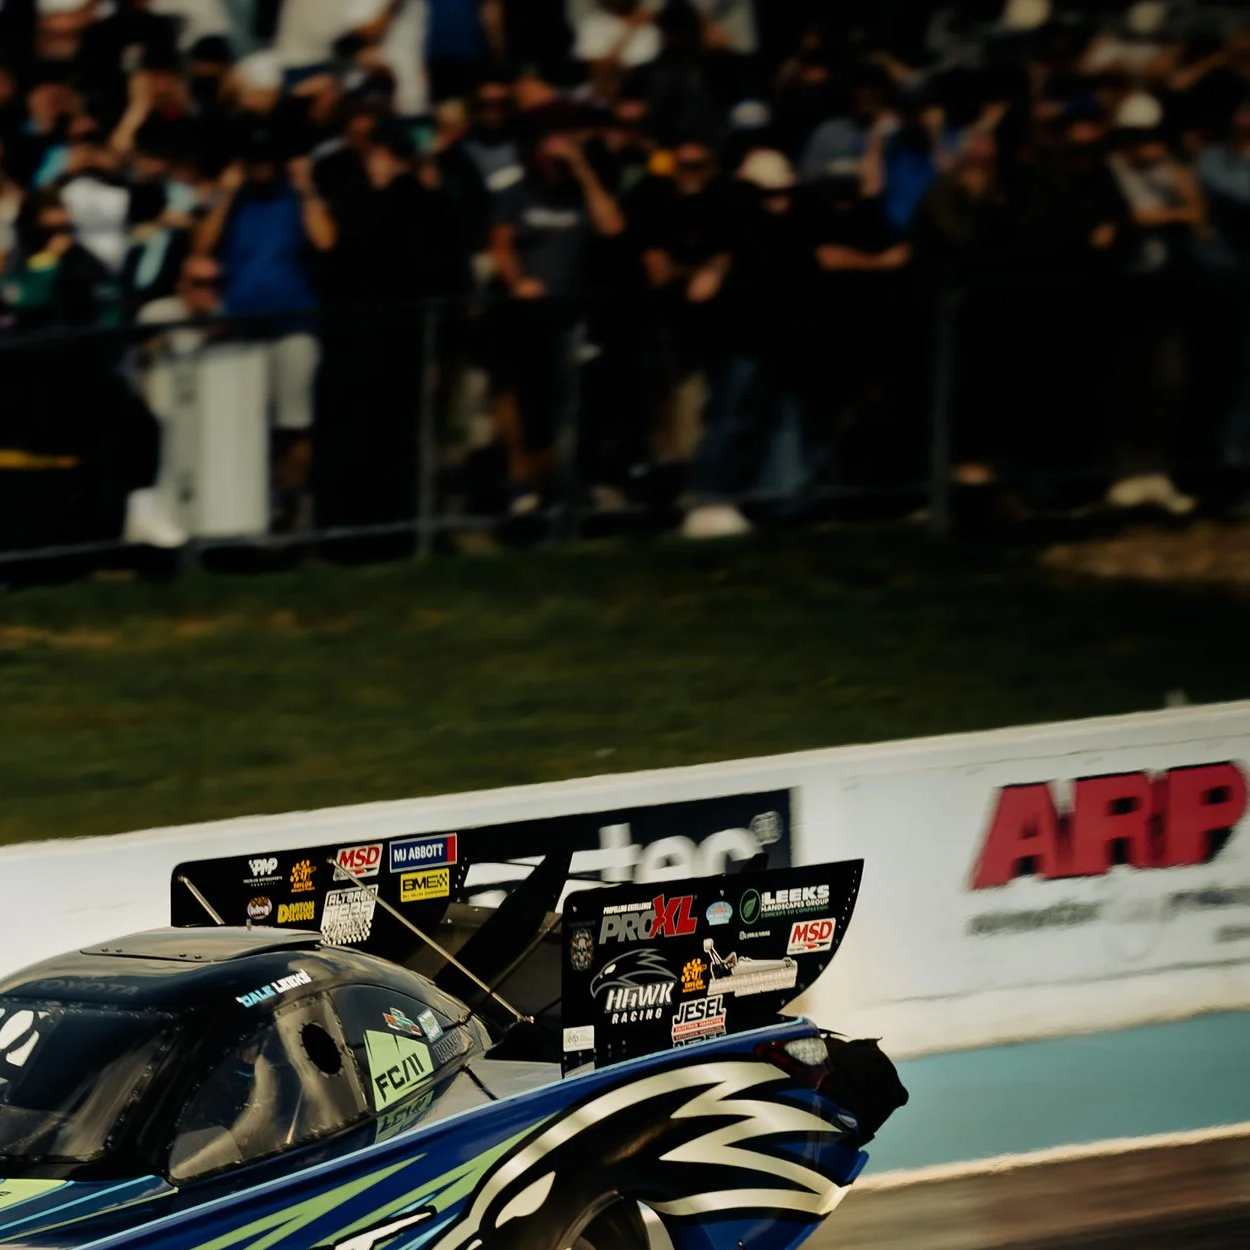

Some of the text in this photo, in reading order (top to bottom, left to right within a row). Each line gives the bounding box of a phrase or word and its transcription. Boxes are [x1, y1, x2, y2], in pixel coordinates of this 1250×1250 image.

[965, 760, 1248, 892] ARP
[338, 846, 380, 868] MSD
[393, 843, 443, 862] MJ ABBOTT
[402, 874, 439, 892] BME
[763, 884, 830, 905] LEEKS
[806, 898, 830, 907] GROUP
[792, 921, 833, 943] MSD
[240, 985, 276, 1008] DALE
[611, 1007, 663, 1025] RACING
[673, 995, 726, 1024] JESEL
[374, 1052, 425, 1104] FC/11
